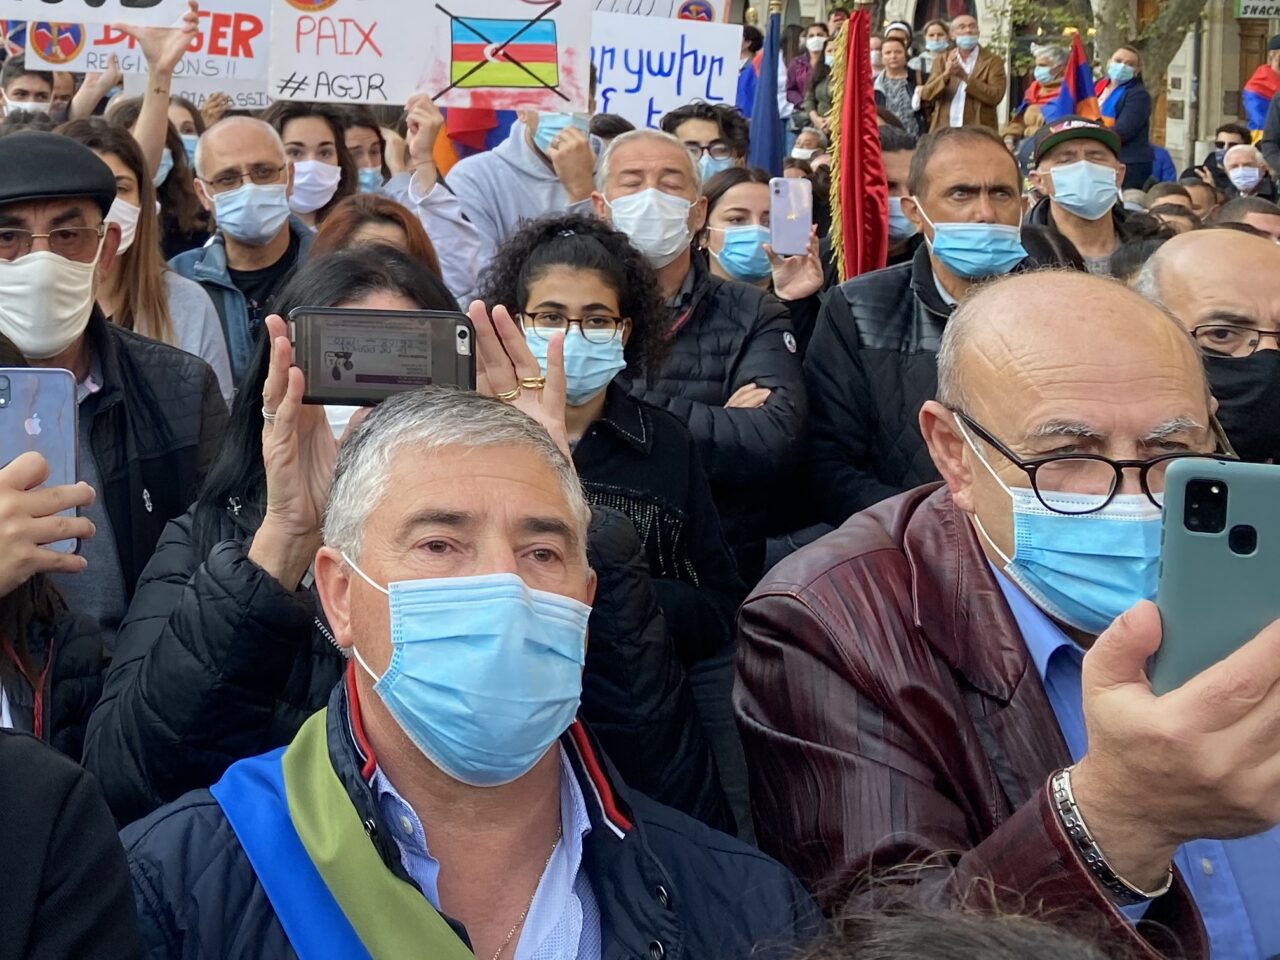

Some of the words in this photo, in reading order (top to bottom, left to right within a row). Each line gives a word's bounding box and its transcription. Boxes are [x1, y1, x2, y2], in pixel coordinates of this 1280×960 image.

[295, 14, 383, 58] PAIX
[86, 51, 220, 77] REAGIONS
[276, 70, 389, 101] #AGJR
